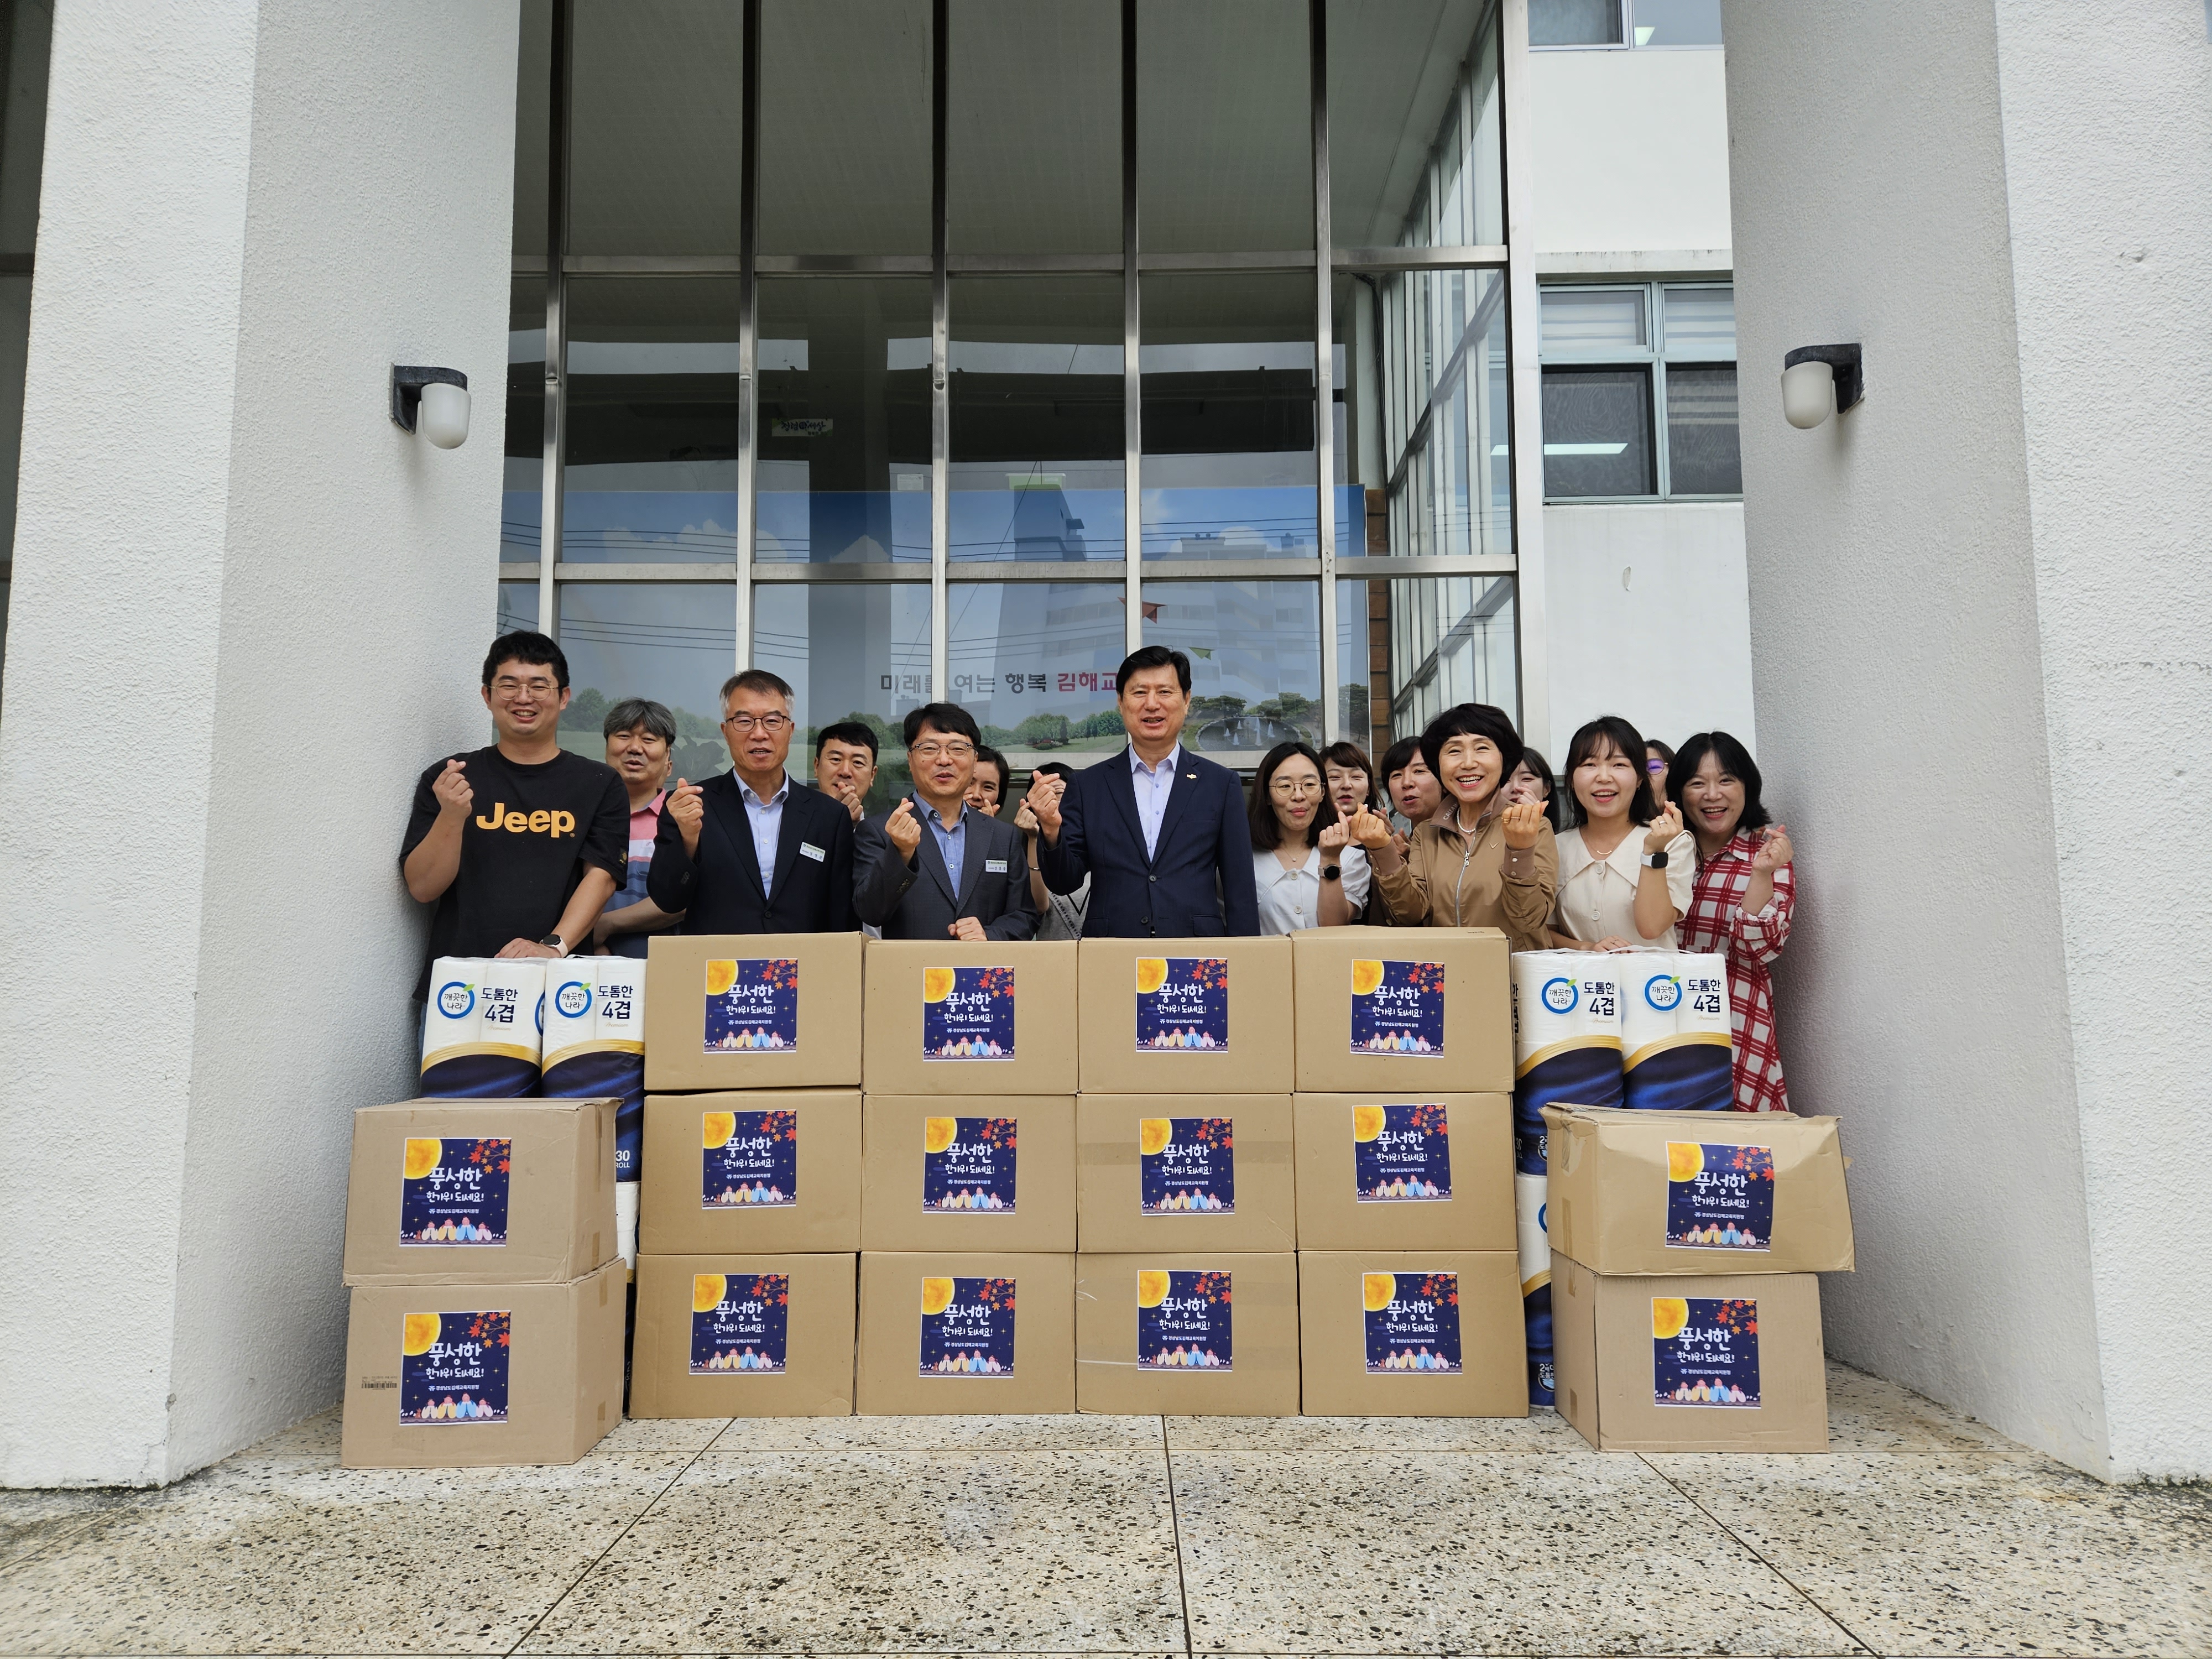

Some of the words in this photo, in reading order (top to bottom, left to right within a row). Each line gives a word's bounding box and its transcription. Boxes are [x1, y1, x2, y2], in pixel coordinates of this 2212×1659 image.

[954, 674, 995, 694] 여는
[1005, 672, 1047, 694] 행복
[476, 802, 575, 838] Jeep
[597, 985, 633, 998] 도톰한
[1584, 982, 1615, 994] 도톰한
[1652, 985, 1675, 994] 깨끗한
[1687, 979, 1721, 992] 도톰한
[444, 993, 468, 1001] 깨끗한
[481, 988, 518, 1001] 도톰한
[562, 993, 585, 1001] 깨끗한
[728, 984, 774, 1005] 풍성한
[1159, 982, 1204, 1003] 풍성한
[1374, 984, 1420, 1007] 풍성한
[1549, 988, 1572, 997] 깨끗한
[946, 992, 991, 1013] 풍성한
[1157, 1004, 1180, 1014] 한가위
[1181, 1005, 1206, 1014] 되세요!
[1589, 998, 1614, 1016] 4겹
[1693, 994, 1720, 1013] 4겹
[484, 1004, 514, 1022] 4겹
[602, 1001, 630, 1019] 4겹
[726, 1005, 749, 1015] 한가위
[750, 1005, 775, 1014] 되세요!
[1372, 1006, 1395, 1016] 한가위
[1397, 1008, 1422, 1018] 되세요!
[944, 1013, 967, 1023] 한가위
[968, 1013, 993, 1022] 되세요!
[726, 1136, 773, 1158] 풍성한
[1377, 1130, 1424, 1152] 풍성한
[615, 1150, 630, 1161] 30
[947, 1142, 993, 1164] 풍성한
[1163, 1143, 1209, 1165] 풍성한
[1376, 1152, 1400, 1163] 한가위
[1402, 1152, 1428, 1161] 되세요!
[724, 1159, 747, 1169] 한가위
[749, 1158, 774, 1167] 되세요!
[945, 1164, 968, 1174] 한가위
[969, 1165, 994, 1174] 되세요!
[1161, 1166, 1185, 1176] 한가위
[1187, 1166, 1212, 1175] 되세요!
[430, 1166, 482, 1191] 풍성한
[1694, 1172, 1748, 1196] 풍성한
[426, 1191, 453, 1203] 한가위
[455, 1192, 484, 1202] 되세요!
[1692, 1194, 1719, 1207] 한가위
[1720, 1197, 1750, 1208] 되세요!
[716, 1300, 763, 1322] 풍성한
[1161, 1296, 1208, 1319] 풍성한
[1387, 1299, 1434, 1322] 풍성한
[945, 1303, 991, 1326] 풍성한
[713, 1323, 737, 1334] 한가위
[739, 1323, 765, 1333] 되세요!
[1159, 1319, 1183, 1330] 한가위
[1185, 1321, 1210, 1330] 되세요!
[1386, 1322, 1410, 1333] 한가위
[1412, 1323, 1438, 1333] 되세요!
[942, 1326, 966, 1337] 한가위
[967, 1327, 993, 1337] 되세요!
[1678, 1326, 1731, 1351] 풍성한
[429, 1342, 482, 1367] 풍성한
[1677, 1351, 1704, 1363] 한가위
[1705, 1353, 1734, 1363] 되세요!
[426, 1368, 453, 1379] 한가위
[455, 1367, 484, 1378] 되세요!
